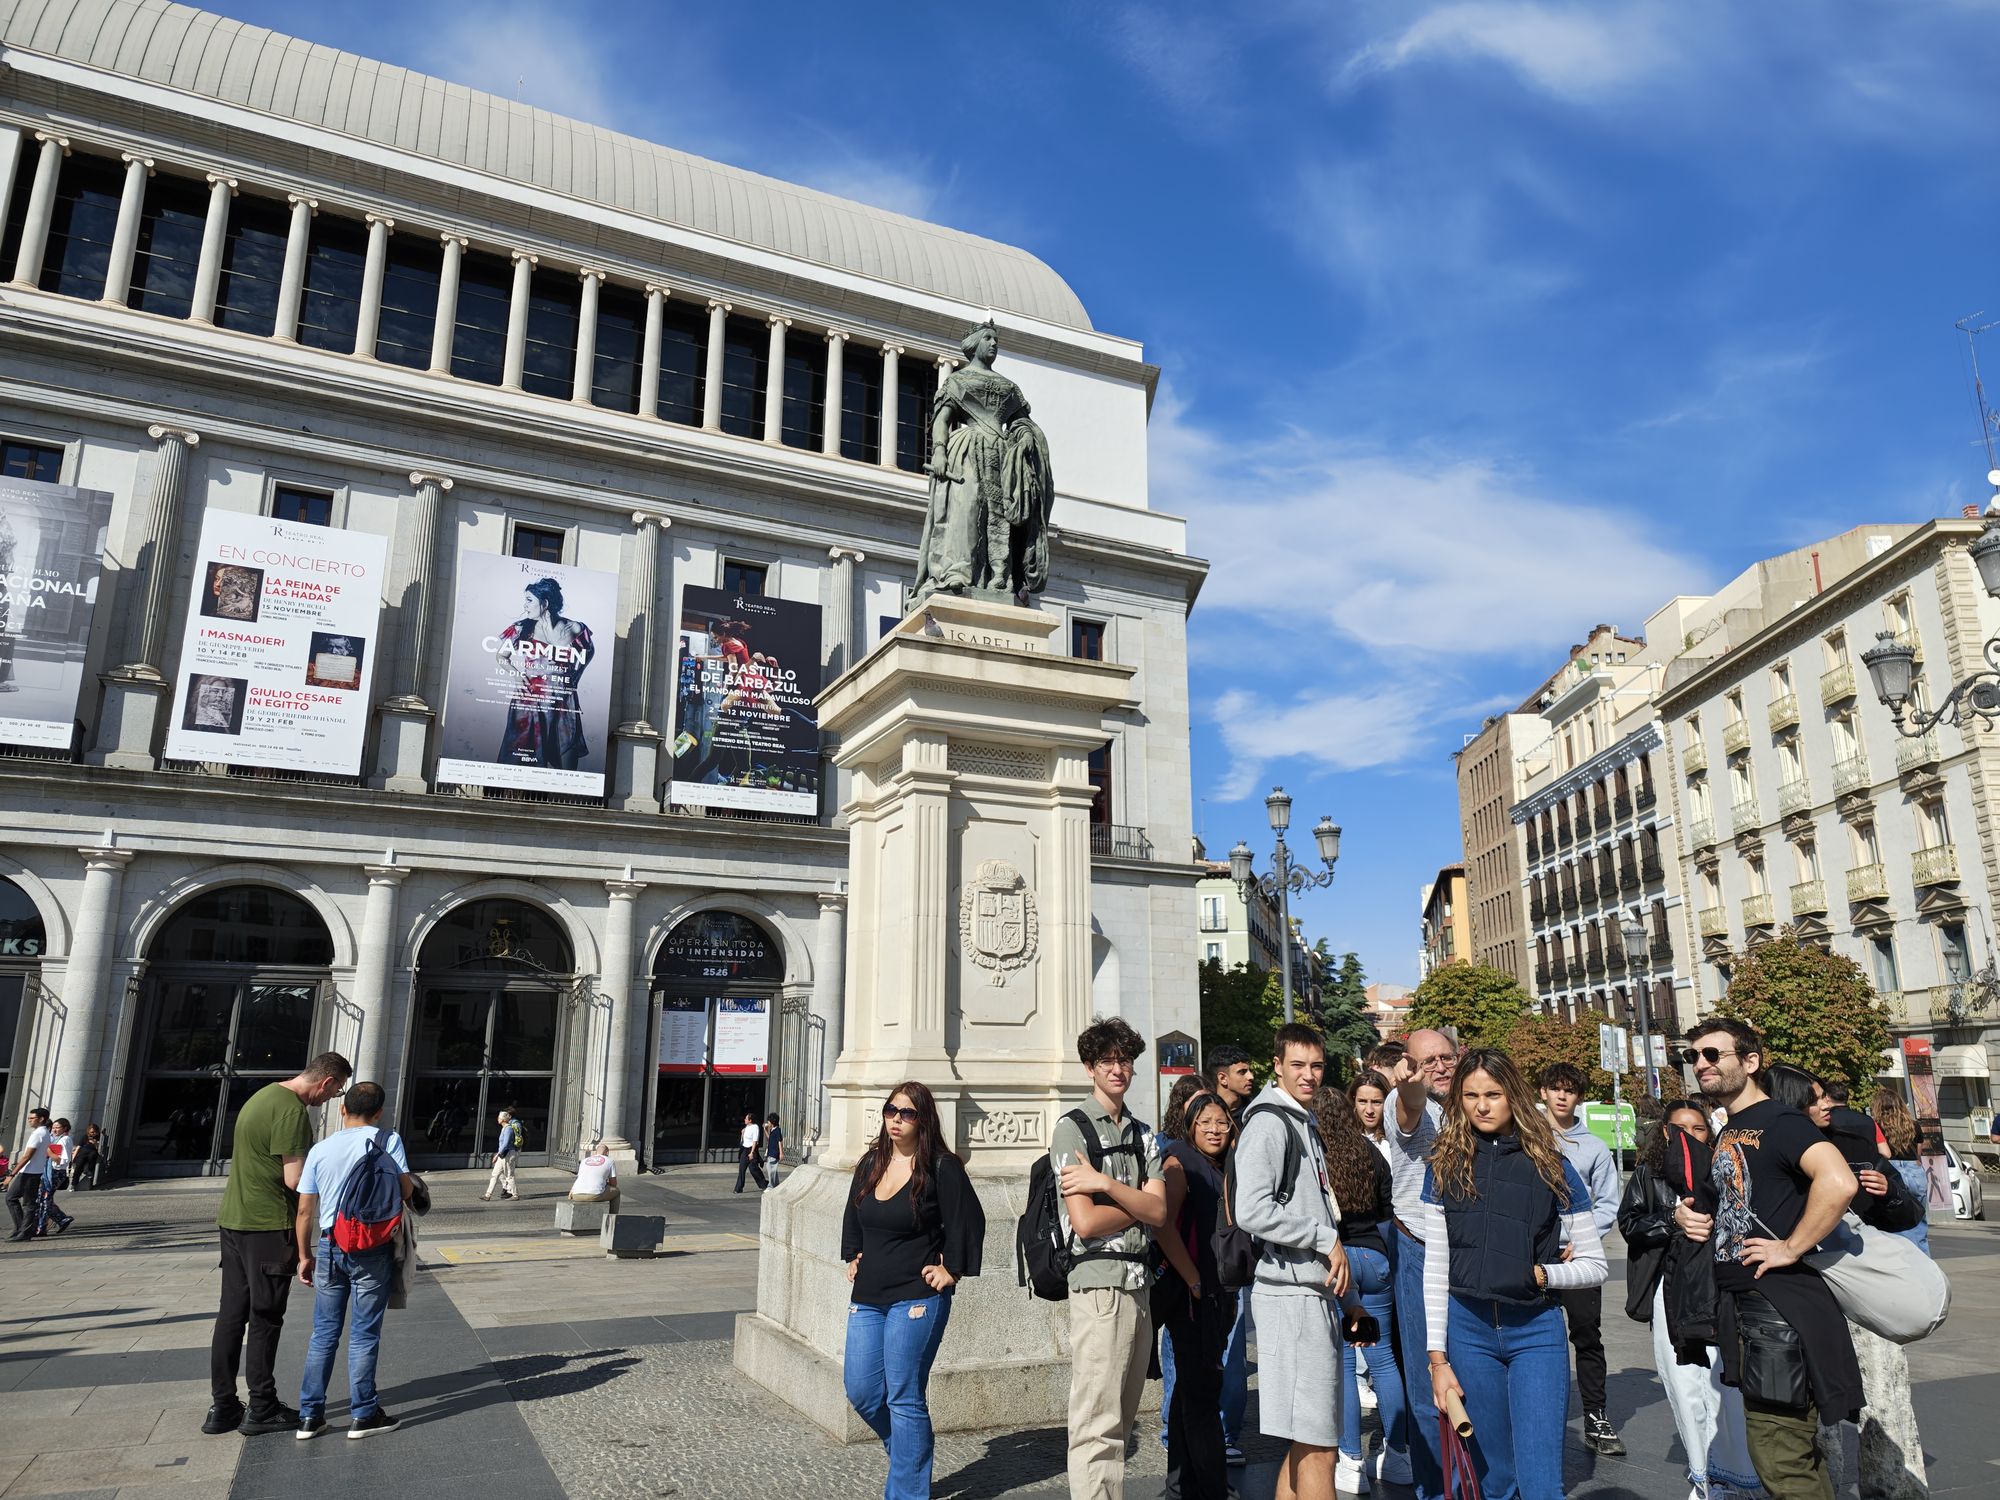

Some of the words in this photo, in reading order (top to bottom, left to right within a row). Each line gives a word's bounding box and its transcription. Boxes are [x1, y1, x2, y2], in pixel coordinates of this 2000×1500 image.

[219, 544, 246, 560] EN
[252, 550, 366, 578] CONCIERTO
[266, 577, 282, 586] LA
[285, 579, 321, 592] REINA
[325, 585, 341, 595] DE
[265, 586, 288, 597] LAS
[291, 590, 332, 603] HADAS
[274, 598, 296, 607] HENRY
[297, 601, 327, 611] PURCELL
[274, 605, 322, 617] NOVIEMBRE
[200, 629, 205, 637] I
[207, 630, 285, 647] MASNADIERI
[209, 641, 243, 652] GIUSEPPE
[244, 645, 265, 654] VERDI
[481, 635, 587, 665] CARMEN
[510, 660, 545, 671] GEORGES
[546, 665, 569, 673] BIZET
[707, 659, 725, 672] EL
[728, 662, 796, 681] CASTILLO
[495, 668, 505, 676] 10
[509, 670, 526, 678] DIC
[551, 676, 571, 684] ENE
[700, 672, 721, 684] DE
[724, 674, 802, 695] BARBAZUL
[250, 687, 292, 699] GIULIO
[295, 692, 343, 705] CESARE
[689, 684, 701, 693] EL
[702, 685, 749, 698] MANDARÍN
[751, 691, 811, 706] MARAVILLOSO
[249, 698, 261, 706] IN
[265, 699, 309, 711] EGITTO
[733, 700, 751, 709] BÉLA
[258, 710, 281, 718] GEORG
[282, 712, 319, 721] FRIEDRICH
[727, 708, 737, 716] 12
[740, 710, 791, 723] NOVIEMBRE
[752, 740, 772, 748] TEATRO
[2, 938, 39, 955] KS
[669, 937, 709, 947] ÓPERA
[668, 947, 684, 955] SU
[689, 948, 764, 958] INTENSIDAD
[702, 967, 728, 977] 2526
[1610, 1114, 1631, 1122] SUR
